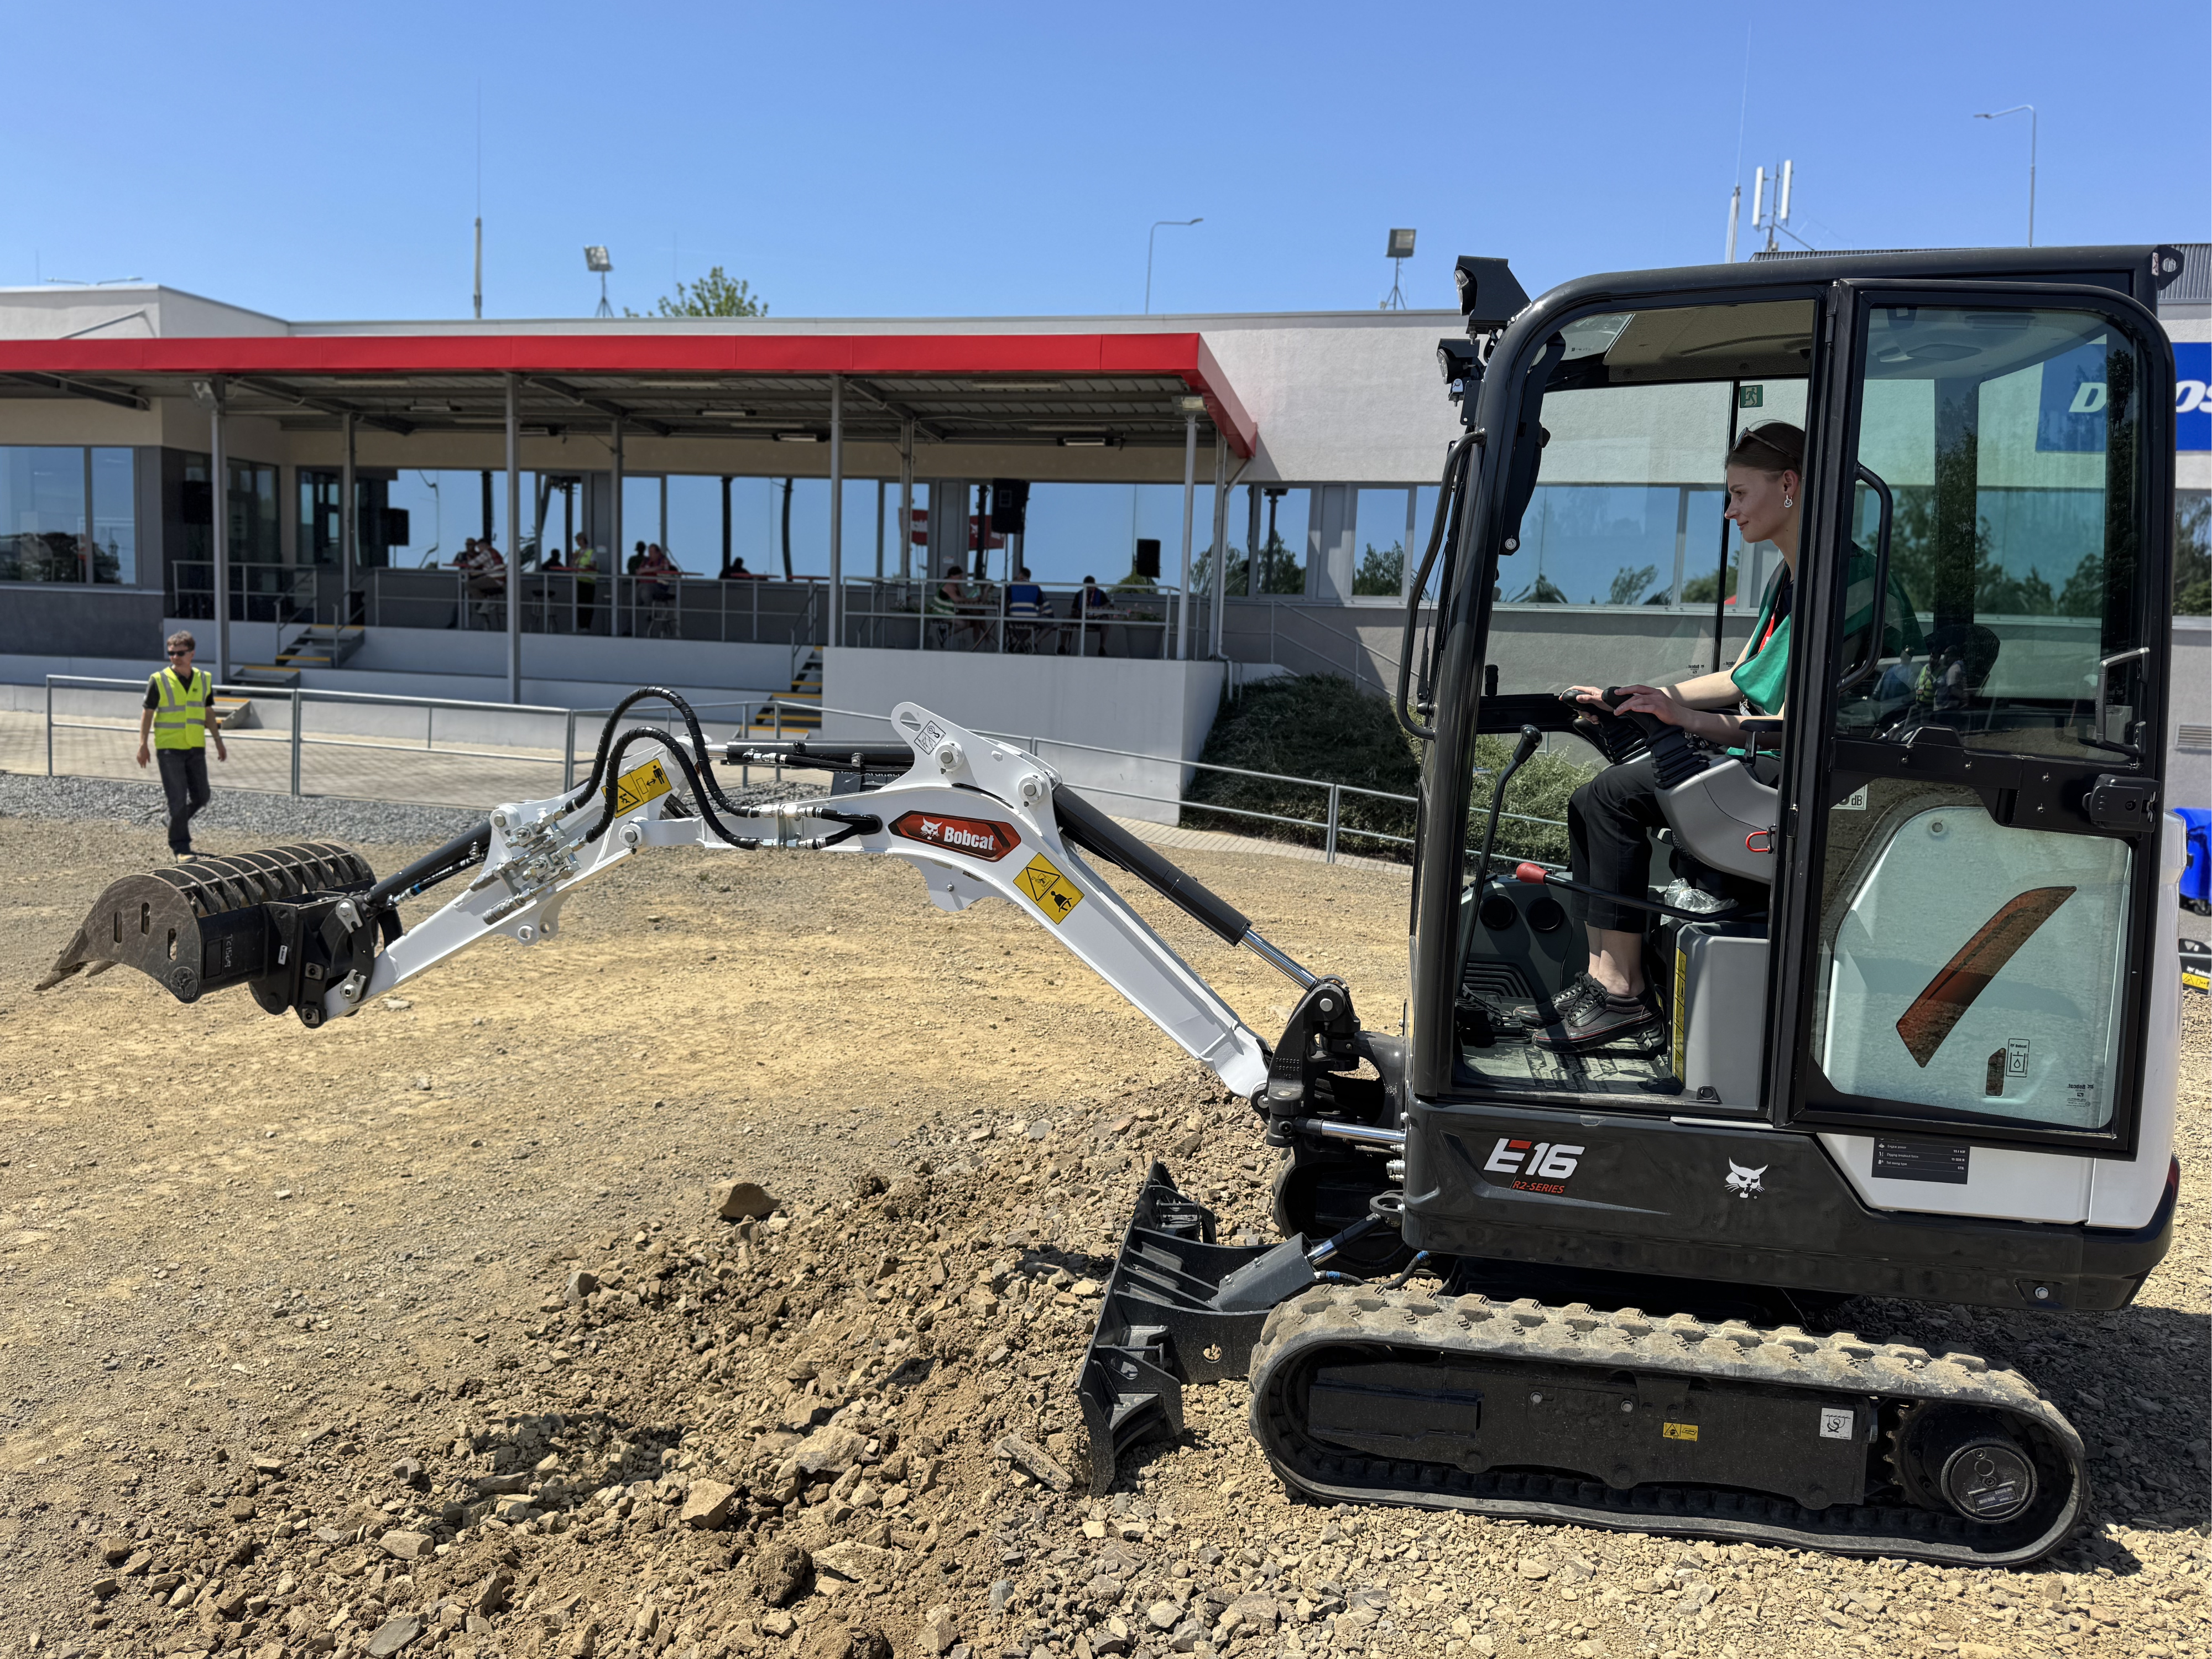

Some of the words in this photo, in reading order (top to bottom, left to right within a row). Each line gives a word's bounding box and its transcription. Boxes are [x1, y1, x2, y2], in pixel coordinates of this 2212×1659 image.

[1851, 795, 1863, 806] dB
[943, 826, 995, 851] Bobcat
[1483, 1138, 1585, 1179] E16
[1511, 1181, 1565, 1194] R2-SERIES
